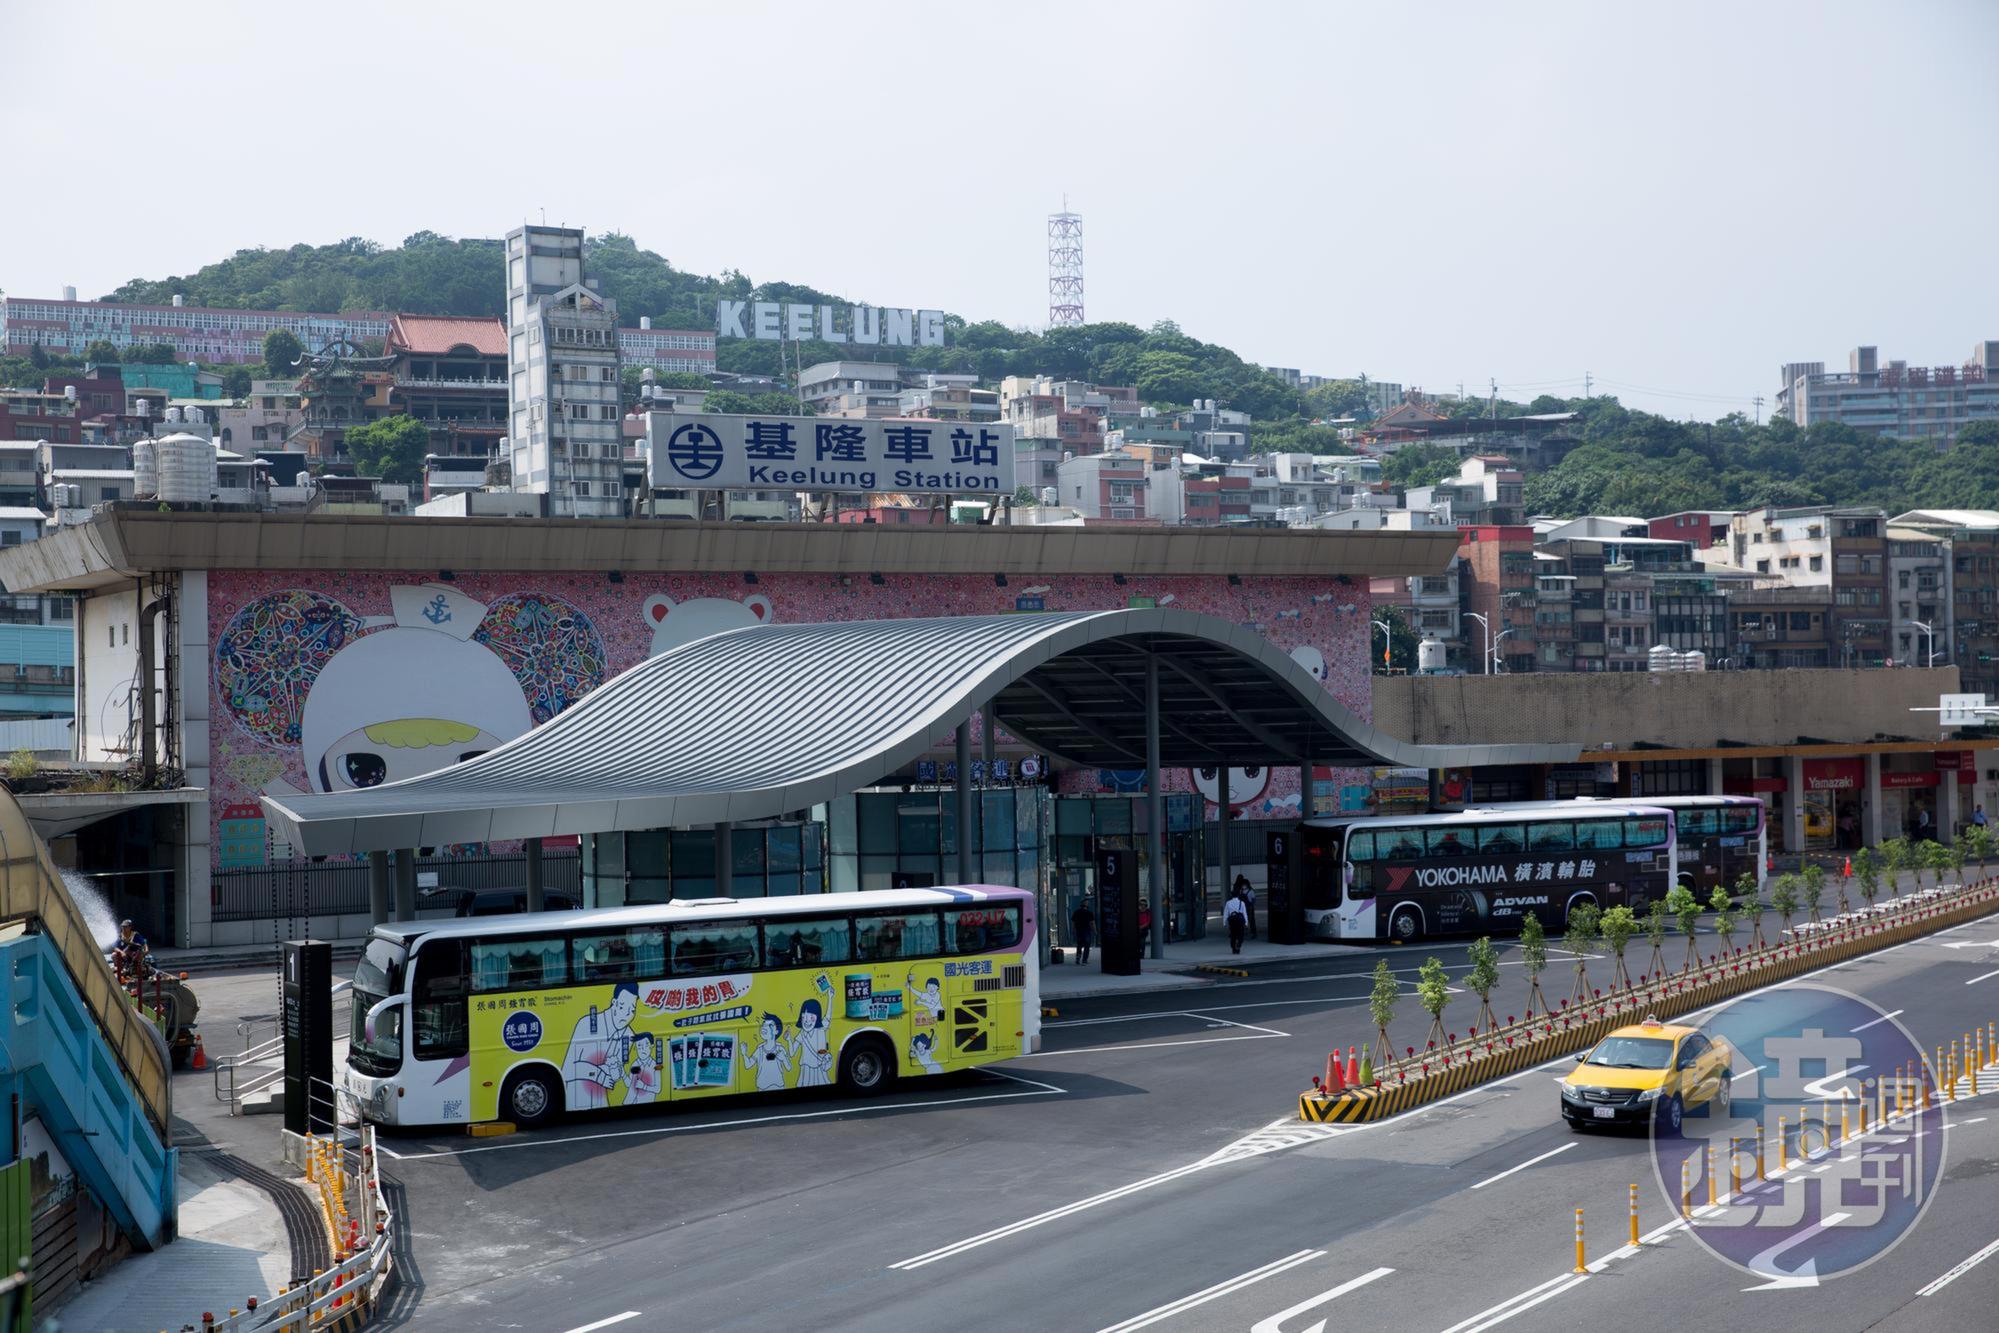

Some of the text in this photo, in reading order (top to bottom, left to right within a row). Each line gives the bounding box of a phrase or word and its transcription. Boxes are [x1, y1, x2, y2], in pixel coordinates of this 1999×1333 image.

[719, 300, 945, 347] KEELUNG
[745, 421, 1000, 467] 基隆車站
[749, 465, 999, 490] Keelung Station
[1808, 775, 1854, 789] Yamazaki
[1274, 837, 1283, 855] 6
[1107, 855, 1116, 876] 5
[1414, 864, 1508, 887] YOKOHAMA
[1492, 895, 1549, 907] ADVAN
[289, 952, 295, 982] 1
[944, 960, 993, 977] 國光客運
[505, 1021, 539, 1036] 張國周
